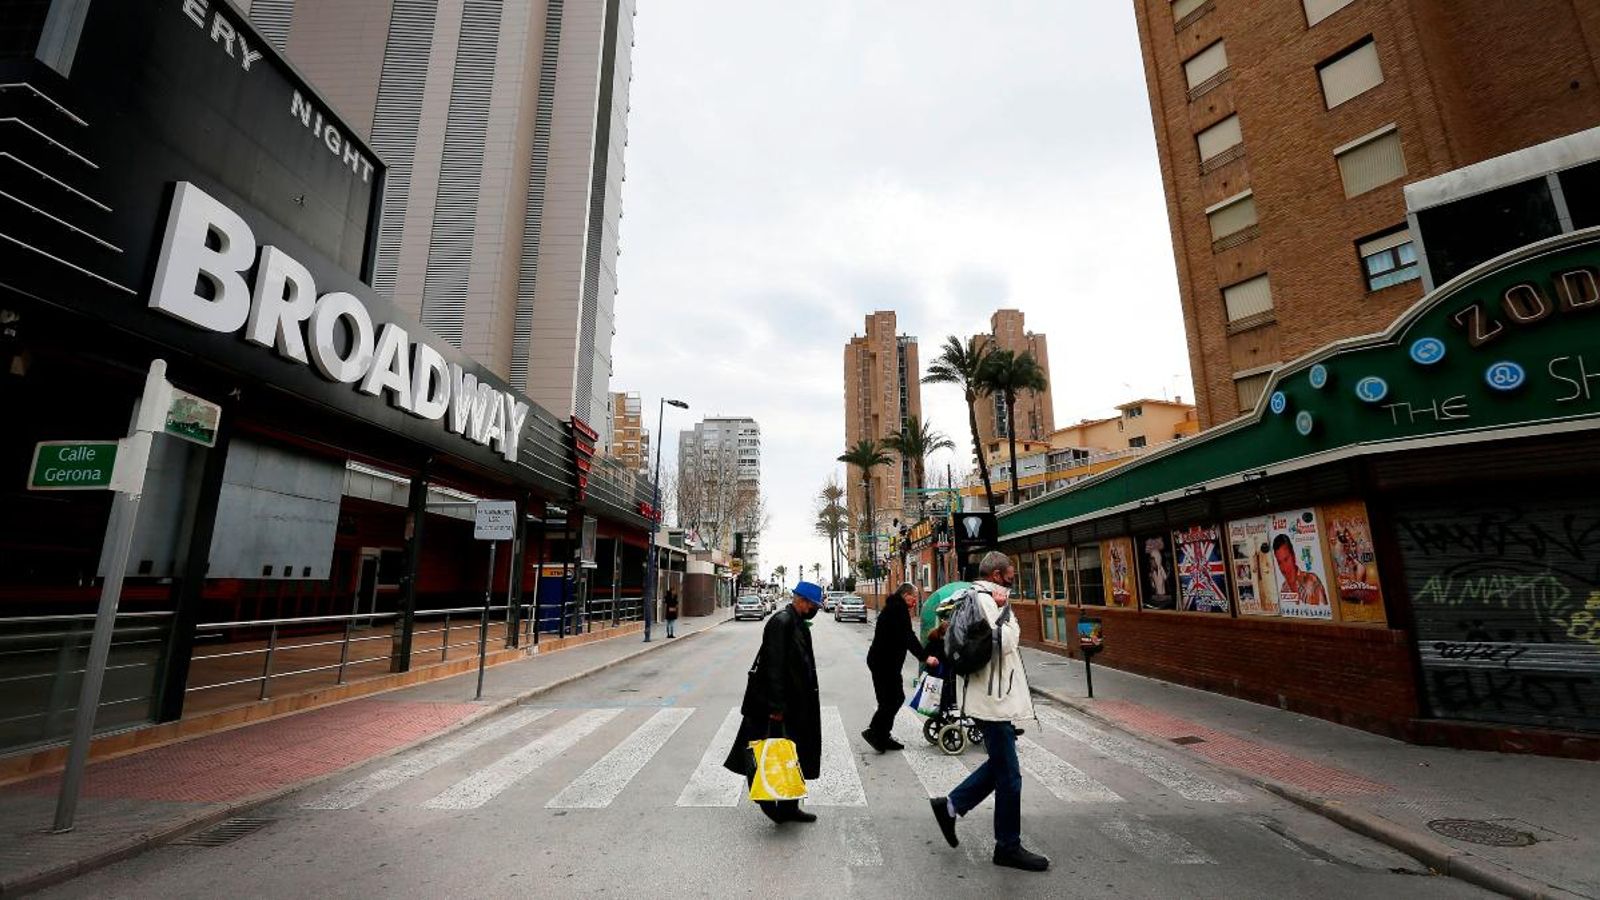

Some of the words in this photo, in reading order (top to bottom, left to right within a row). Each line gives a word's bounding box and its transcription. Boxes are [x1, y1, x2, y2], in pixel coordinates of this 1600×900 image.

[291, 89, 374, 182] NIGHT
[149, 181, 529, 462] BROADWAY
[1453, 266, 1600, 345] ZOD
[1380, 394, 1470, 425] THE
[44, 467, 101, 482] Gerona
[58, 446, 96, 462] Calle
